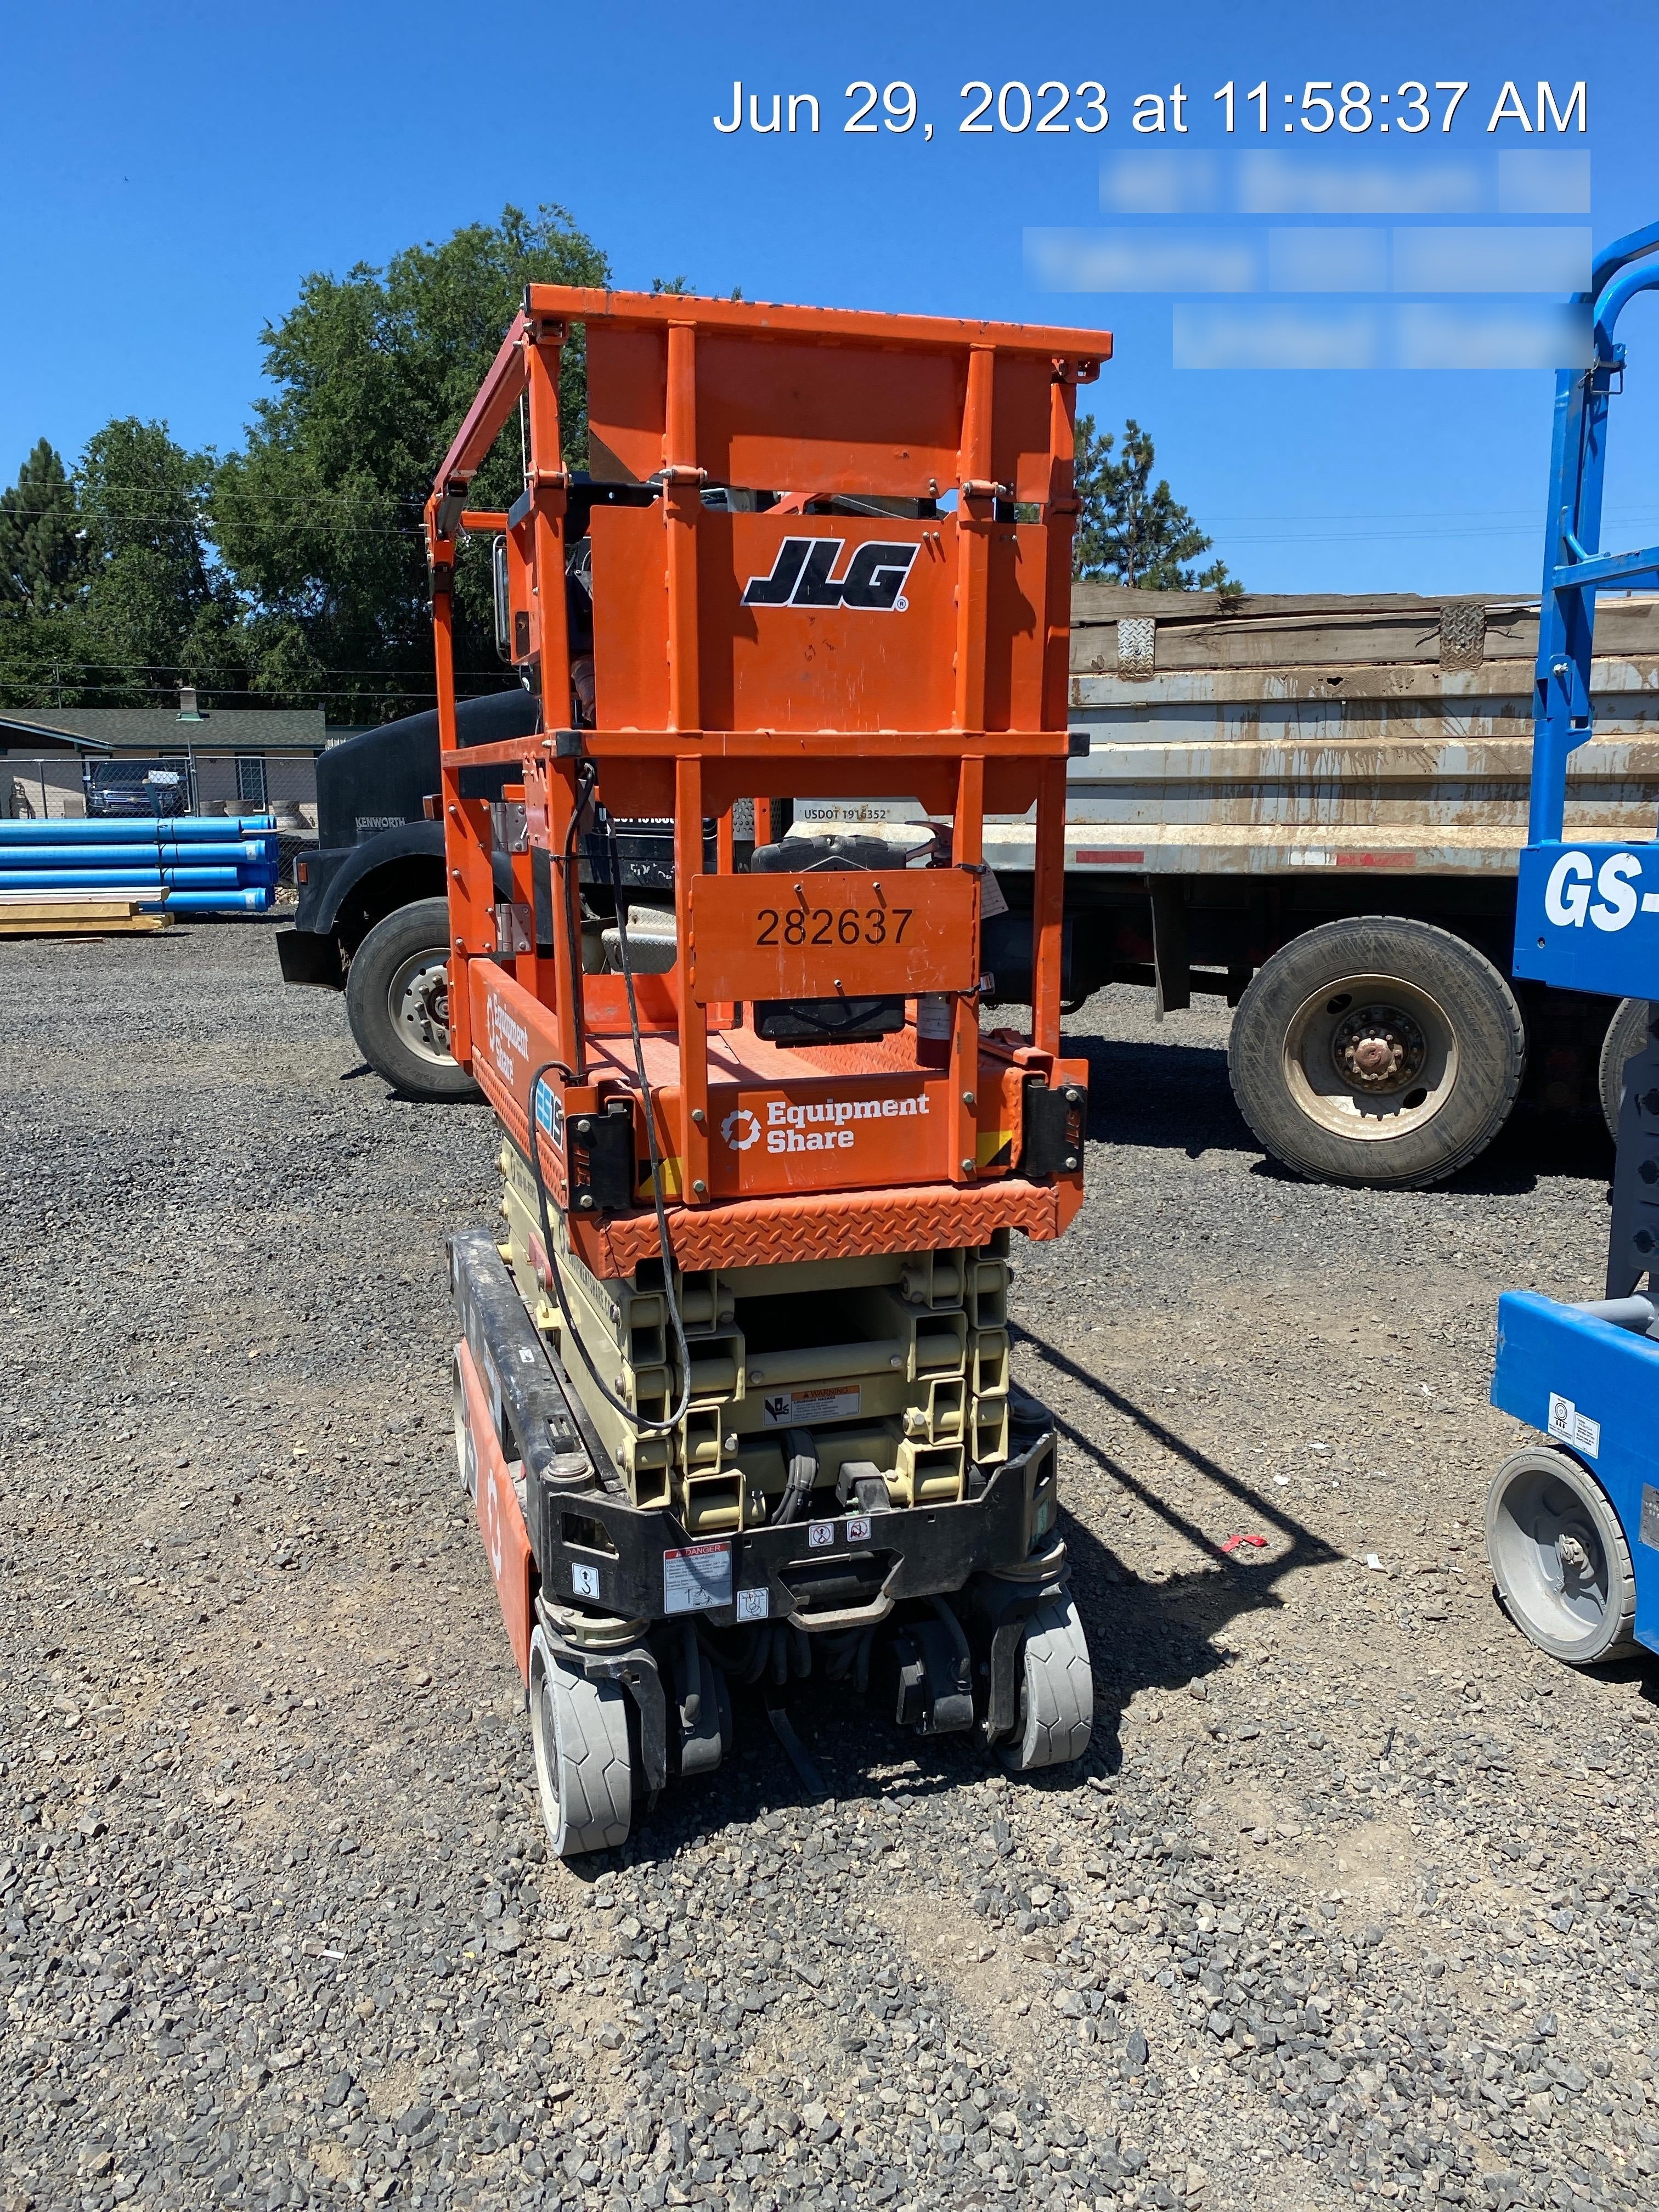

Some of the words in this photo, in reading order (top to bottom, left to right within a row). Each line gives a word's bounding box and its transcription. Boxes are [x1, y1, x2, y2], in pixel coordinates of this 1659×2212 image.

[355, 817, 405, 828] KENWORTH
[804, 809, 838, 820] USDOT
[842, 809, 887, 820] 1916352
[757, 909, 913, 946] 282637
[493, 993, 529, 1062] Equipment
[496, 1036, 515, 1085] Share
[767, 1094, 930, 1129] Equipment
[767, 1128, 855, 1154] Share
[811, 1387, 849, 1397] WARNING
[685, 1545, 721, 1555] DANGER
